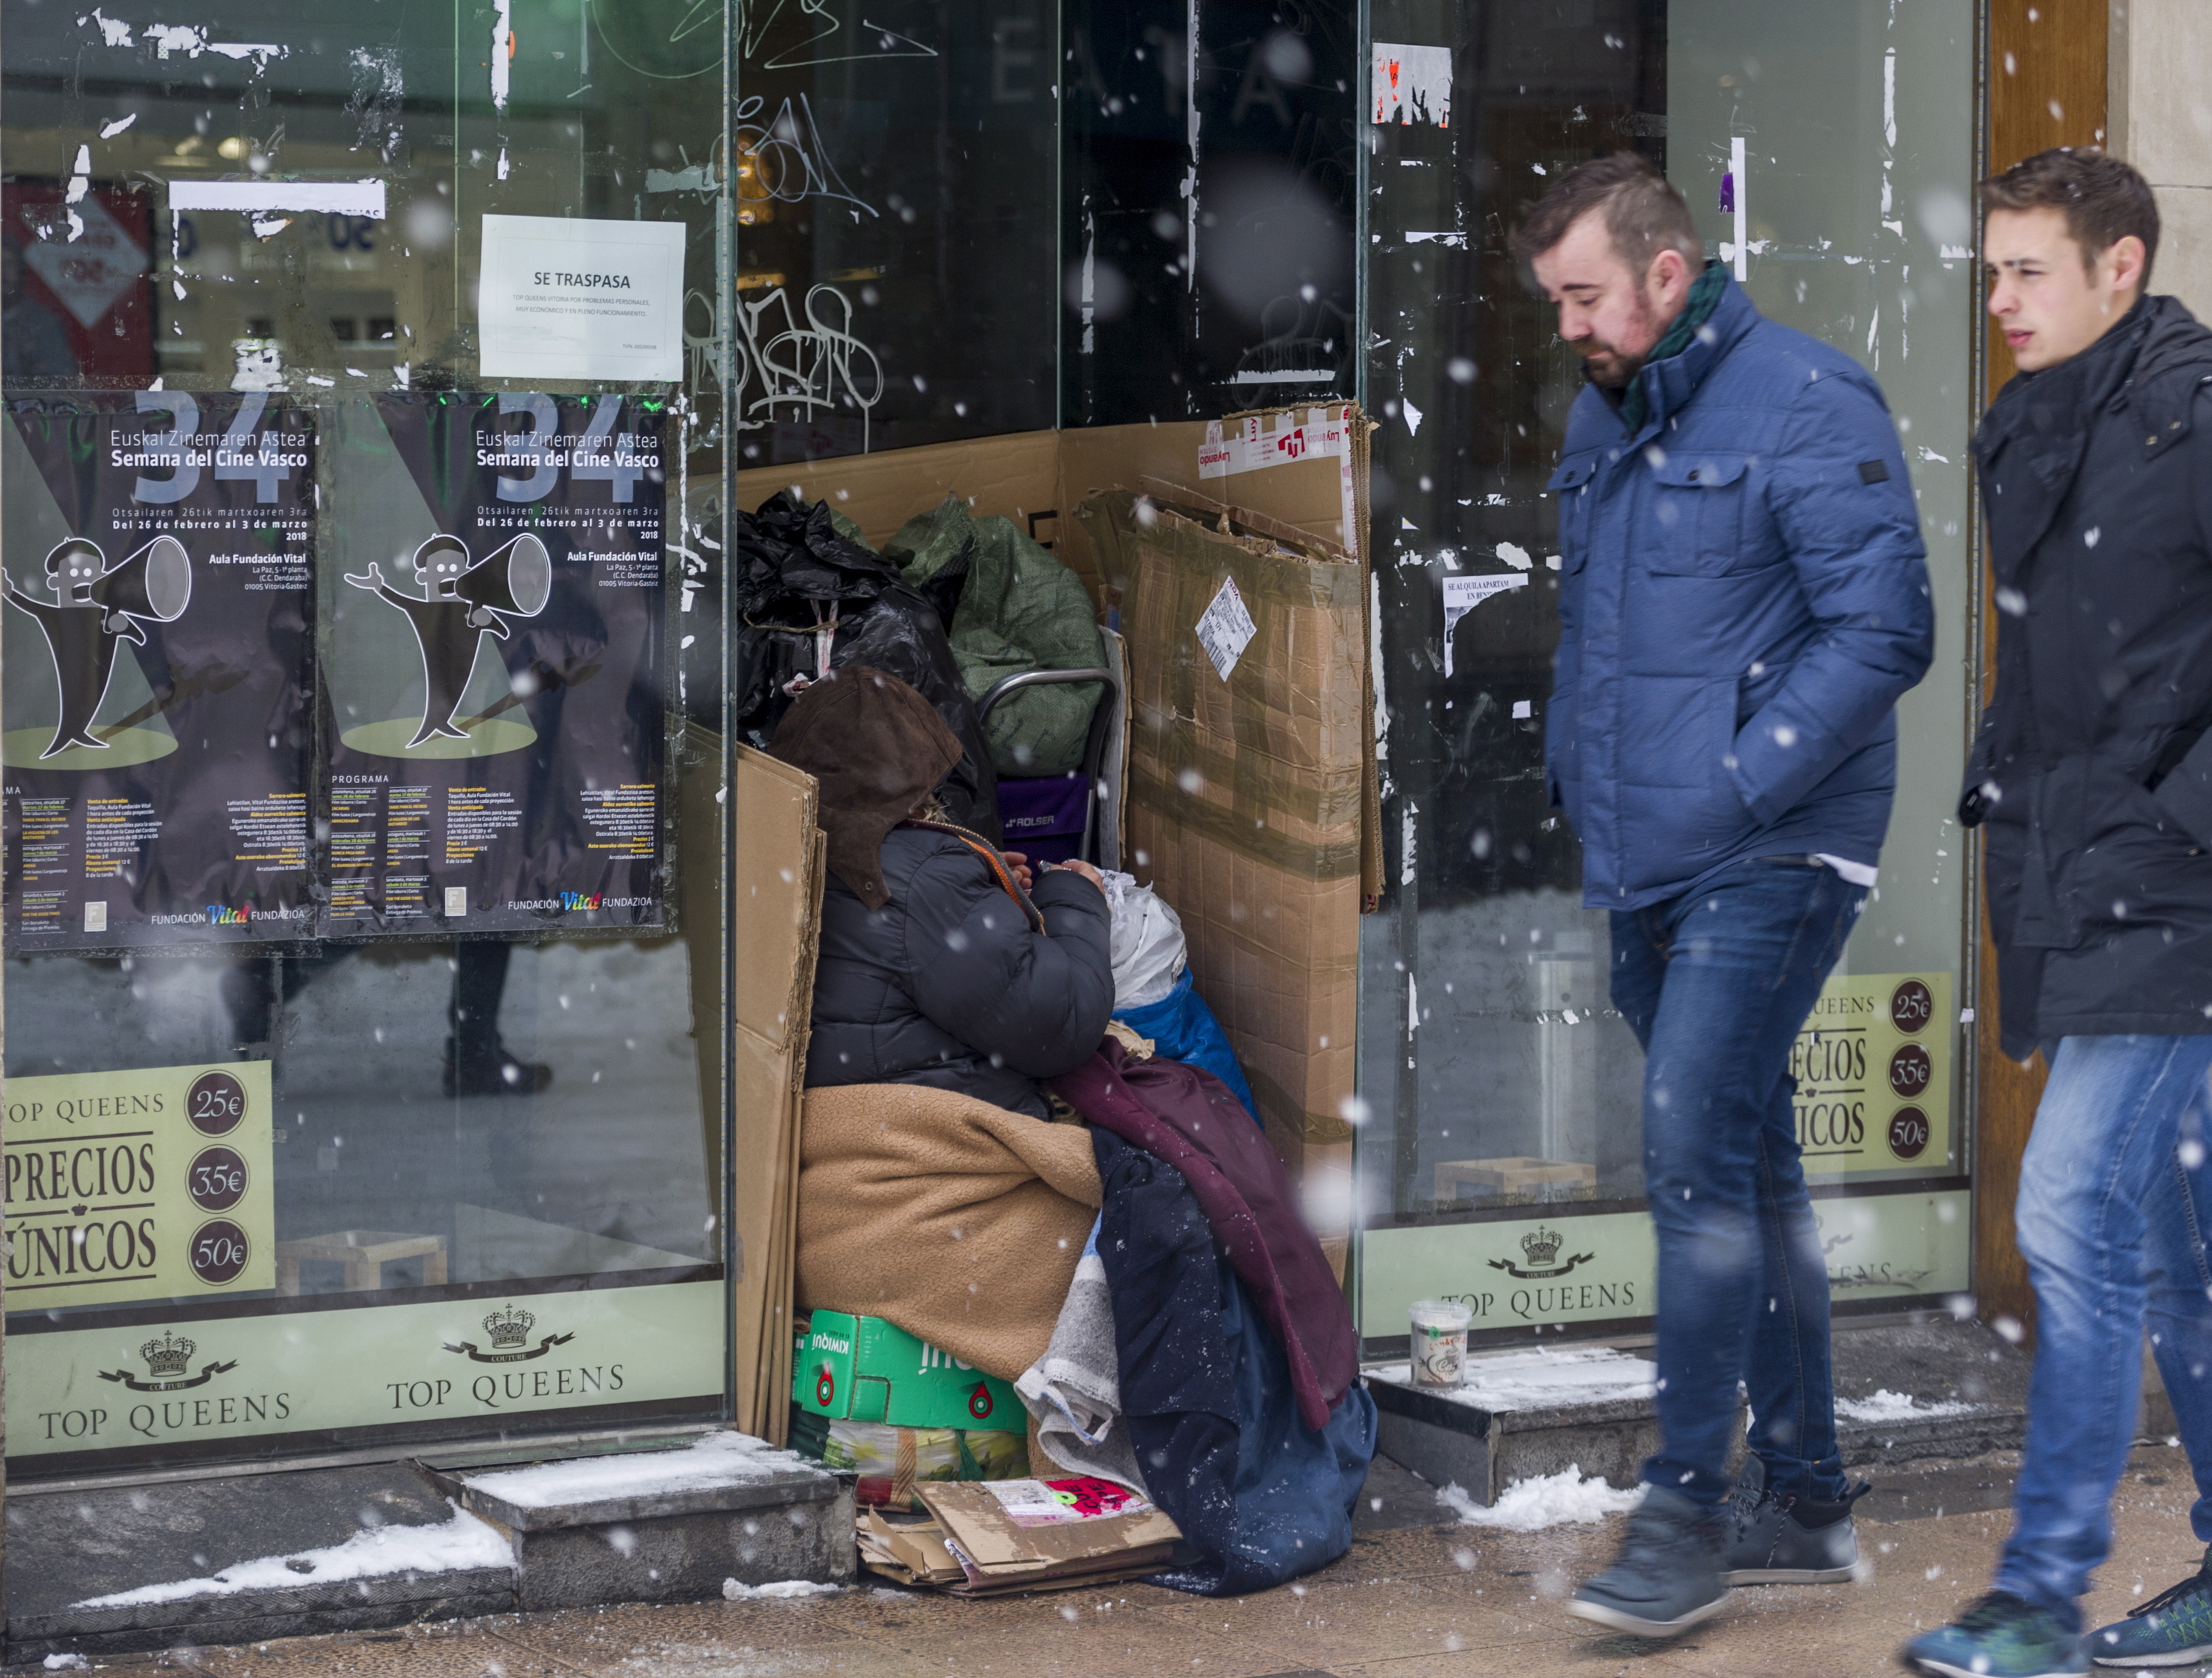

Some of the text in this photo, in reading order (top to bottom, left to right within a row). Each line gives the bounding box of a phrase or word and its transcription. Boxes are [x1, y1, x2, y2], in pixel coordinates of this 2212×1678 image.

[534, 271, 630, 288] SE TRASPASA
[530, 306, 563, 314] ECONÓMICO
[597, 309, 647, 317] FUNCIONAMIENTO.
[111, 430, 306, 446] Euskal Zinemaren Astea
[476, 431, 657, 448] Euskal Zinemaren Astea
[1307, 430, 1340, 443] Luyando
[134, 391, 289, 504] 34
[496, 394, 643, 503] 34
[111, 449, 307, 467] Semana del Cine Vasco
[477, 450, 658, 468] Semana del Cine Vasco
[1200, 451, 1231, 467] Luyando
[112, 507, 307, 517] Otsailaren 26tik martxoaren 3ra
[477, 506, 658, 516] Otsailaren 26tik martxoaren 3ra
[113, 520, 307, 529] Del 26 de febrero al 3 de marzo
[478, 518, 659, 528] Del 26 de febrero al 3 de marzo
[286, 533, 307, 541] 2018
[640, 531, 658, 540] 2018
[209, 553, 306, 564] Aula Fundación Vital
[567, 551, 657, 561] Aula Fundación Vital
[1457, 582, 1483, 591] ALQUILA
[1483, 580, 1509, 588] APARTAM
[332, 775, 389, 783] PROGRAMA
[1017, 815, 1054, 826] ROLSER
[508, 891, 653, 911] FUNDACIÓN Vital FUNDAZIOA
[151, 905, 305, 925] FUNDACIÓN Vital FUNDAZIOA
[1807, 996, 1875, 1019] UEENS
[1895, 995, 1929, 1019] 25€
[1891, 1059, 1928, 1085] 35€
[4, 1093, 164, 1124] OP QUEENS
[193, 1089, 240, 1118] 25€
[1794, 1101, 1865, 1146] ICOS
[1891, 1121, 1927, 1146] 50€
[4, 1143, 155, 1202] PRECIOS
[192, 1164, 242, 1196] 35€
[5, 1218, 156, 1279] ÚNICOS
[195, 1238, 244, 1268] 50€
[1511, 1282, 1635, 1320] QUEENS
[812, 1333, 849, 1354] KIWIQUÍ
[491, 1354, 527, 1362] COUTURE
[149, 1382, 187, 1391] COUTURE
[386, 1364, 623, 1409] TOP QUEENS
[38, 1393, 290, 1440] TOP QUEENS
